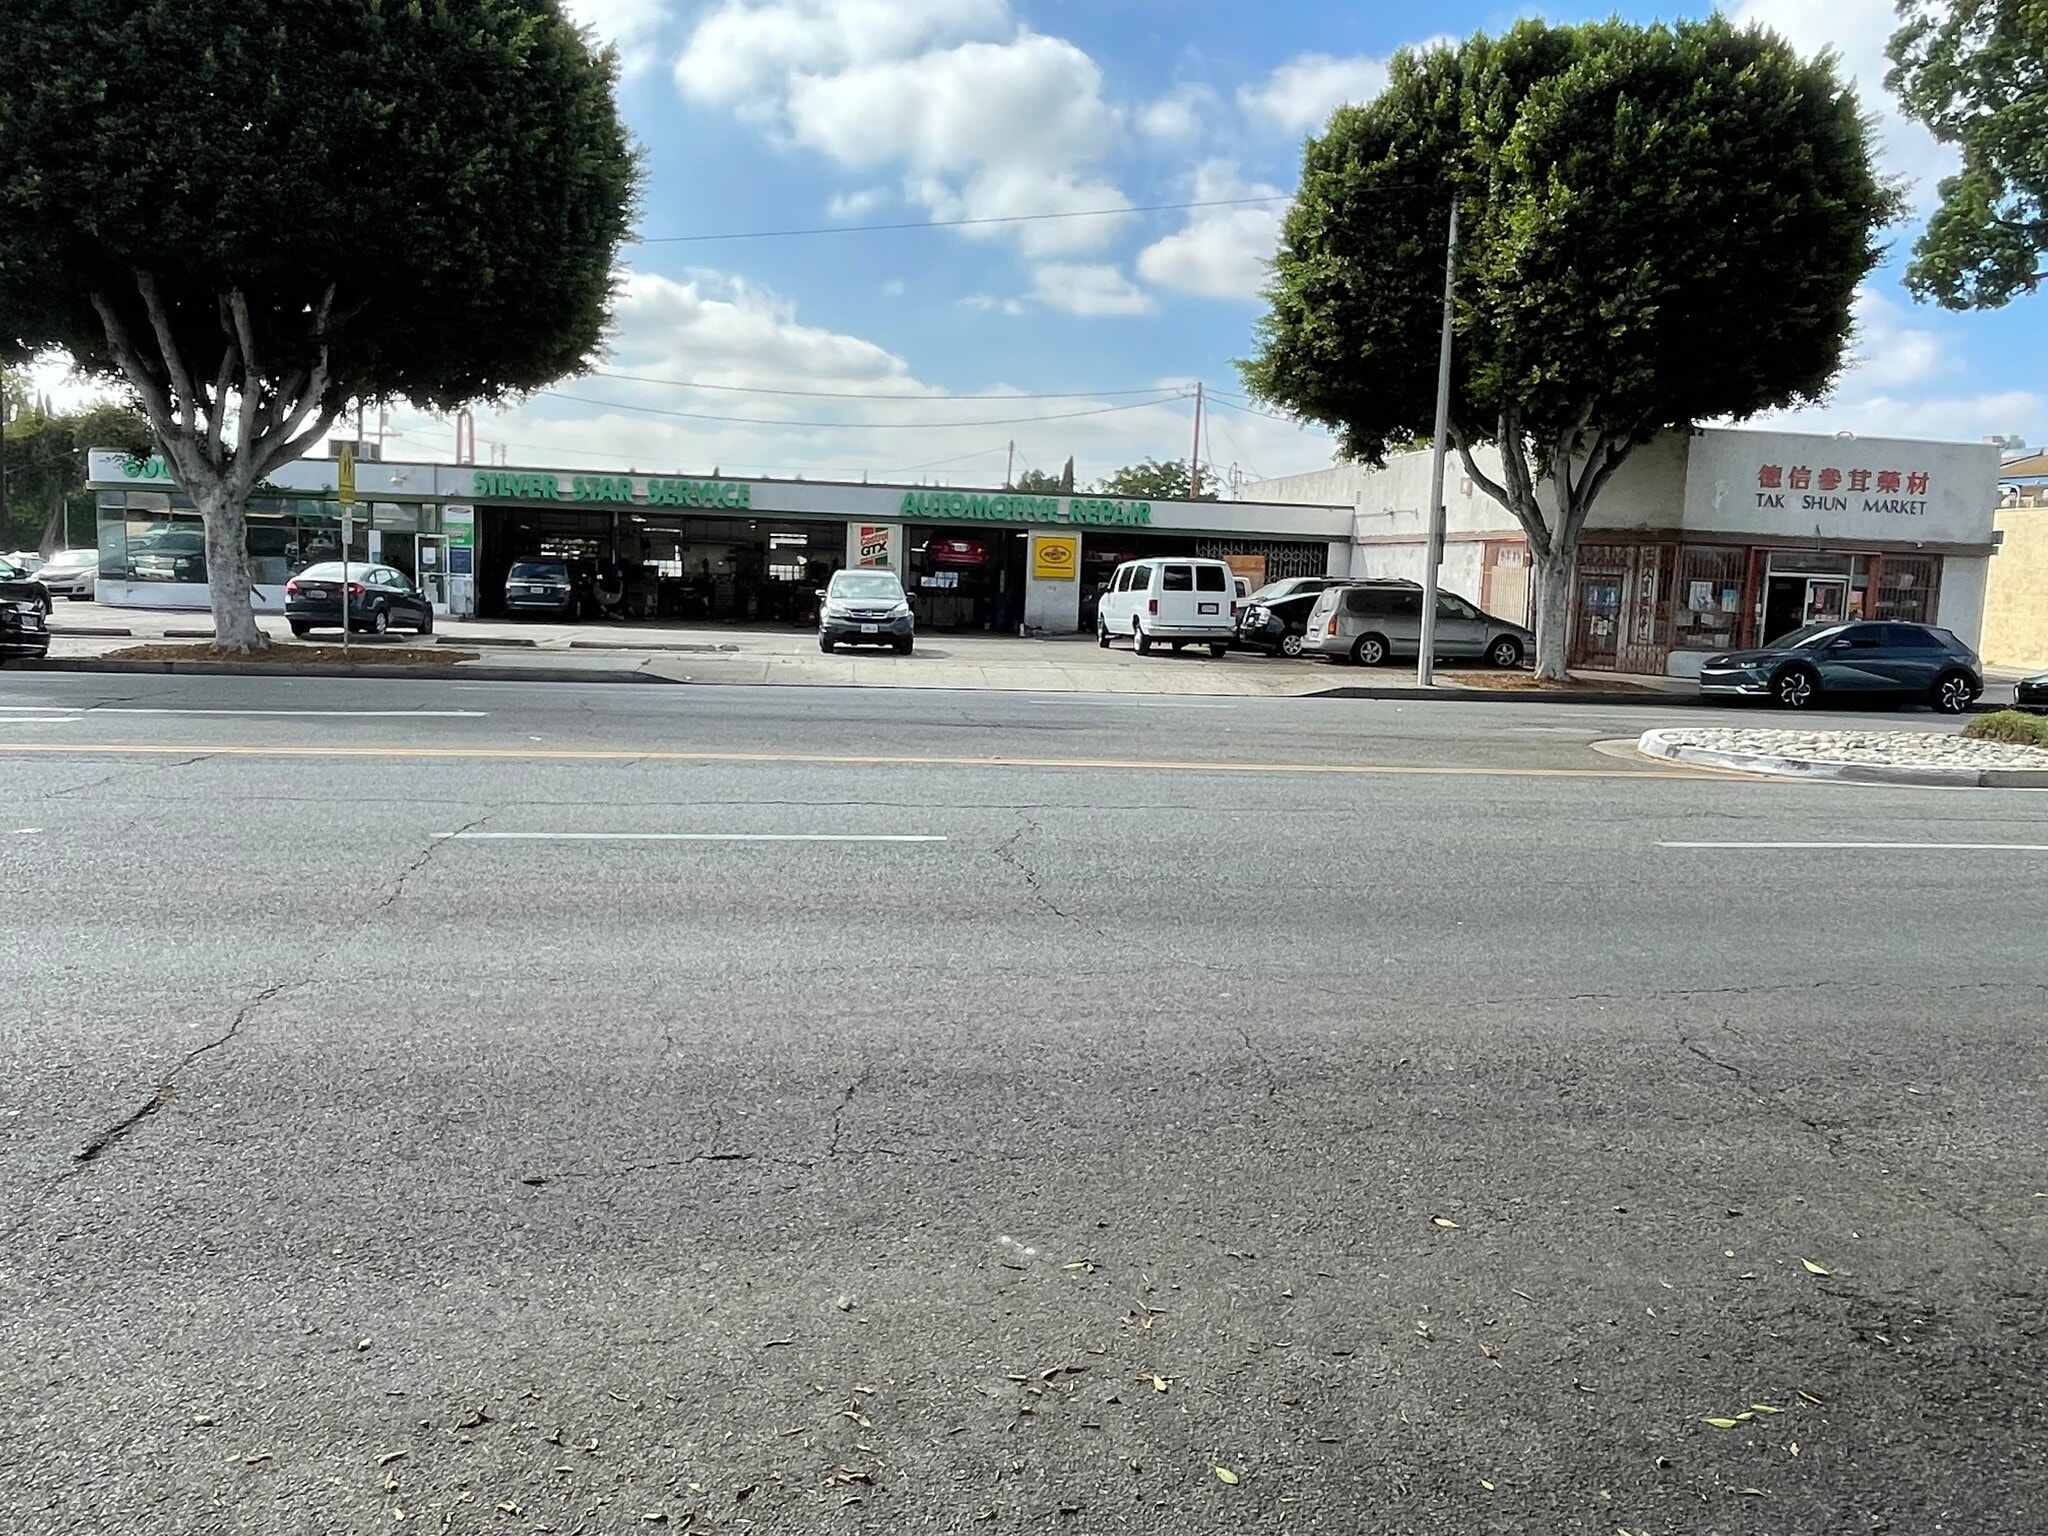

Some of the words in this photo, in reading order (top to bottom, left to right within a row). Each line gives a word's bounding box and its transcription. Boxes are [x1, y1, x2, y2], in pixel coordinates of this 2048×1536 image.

[473, 470, 559, 498] SILVER
[571, 475, 634, 502] STAR
[646, 479, 751, 510] SERVICE
[1755, 492, 1785, 509] TAK
[1802, 495, 1848, 512] SHUN
[1862, 499, 1928, 516] MARKET
[900, 491, 1060, 523] AUTOMOTIVE
[1068, 500, 1152, 526] REPAIR
[860, 540, 888, 557] GTX
